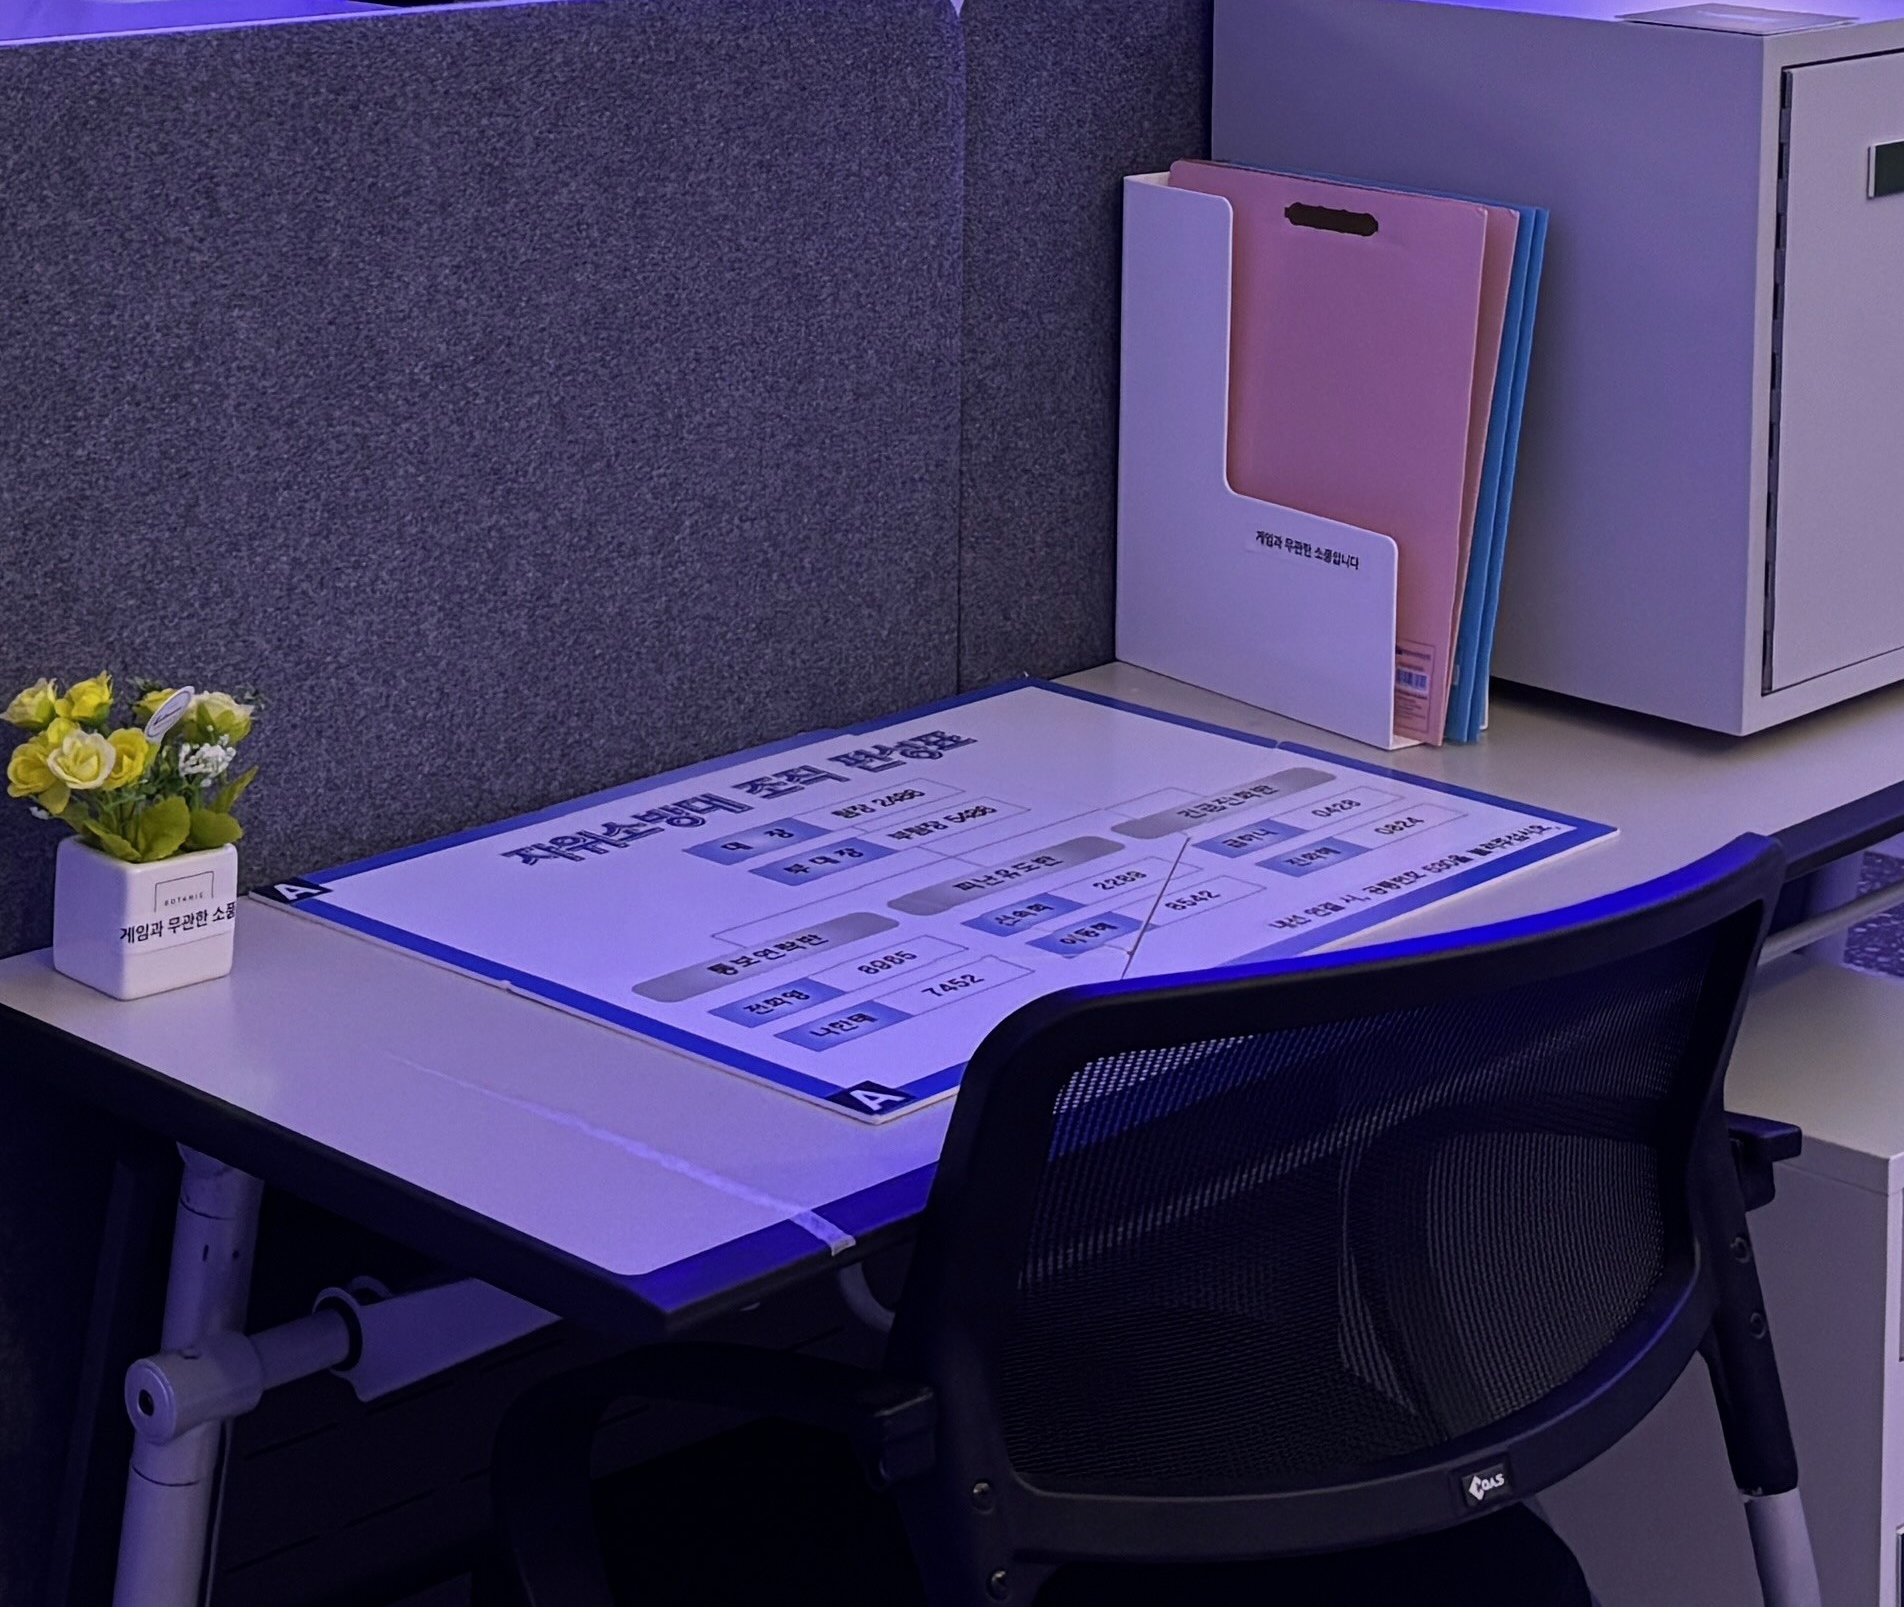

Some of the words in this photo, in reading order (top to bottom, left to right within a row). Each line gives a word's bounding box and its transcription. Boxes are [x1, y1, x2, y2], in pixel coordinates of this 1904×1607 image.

[501, 792, 752, 865] 자위소방대
[731, 764, 852, 801] 조직
[827, 730, 978, 773] 편성표
[275, 883, 333, 900] A
[1164, 889, 1221, 912] 8542
[120, 920, 162, 944] 게임과
[167, 909, 209, 932] 무관한
[707, 933, 829, 976] 통보연락반
[921, 973, 985, 998] 7452
[849, 1088, 905, 1112] A
